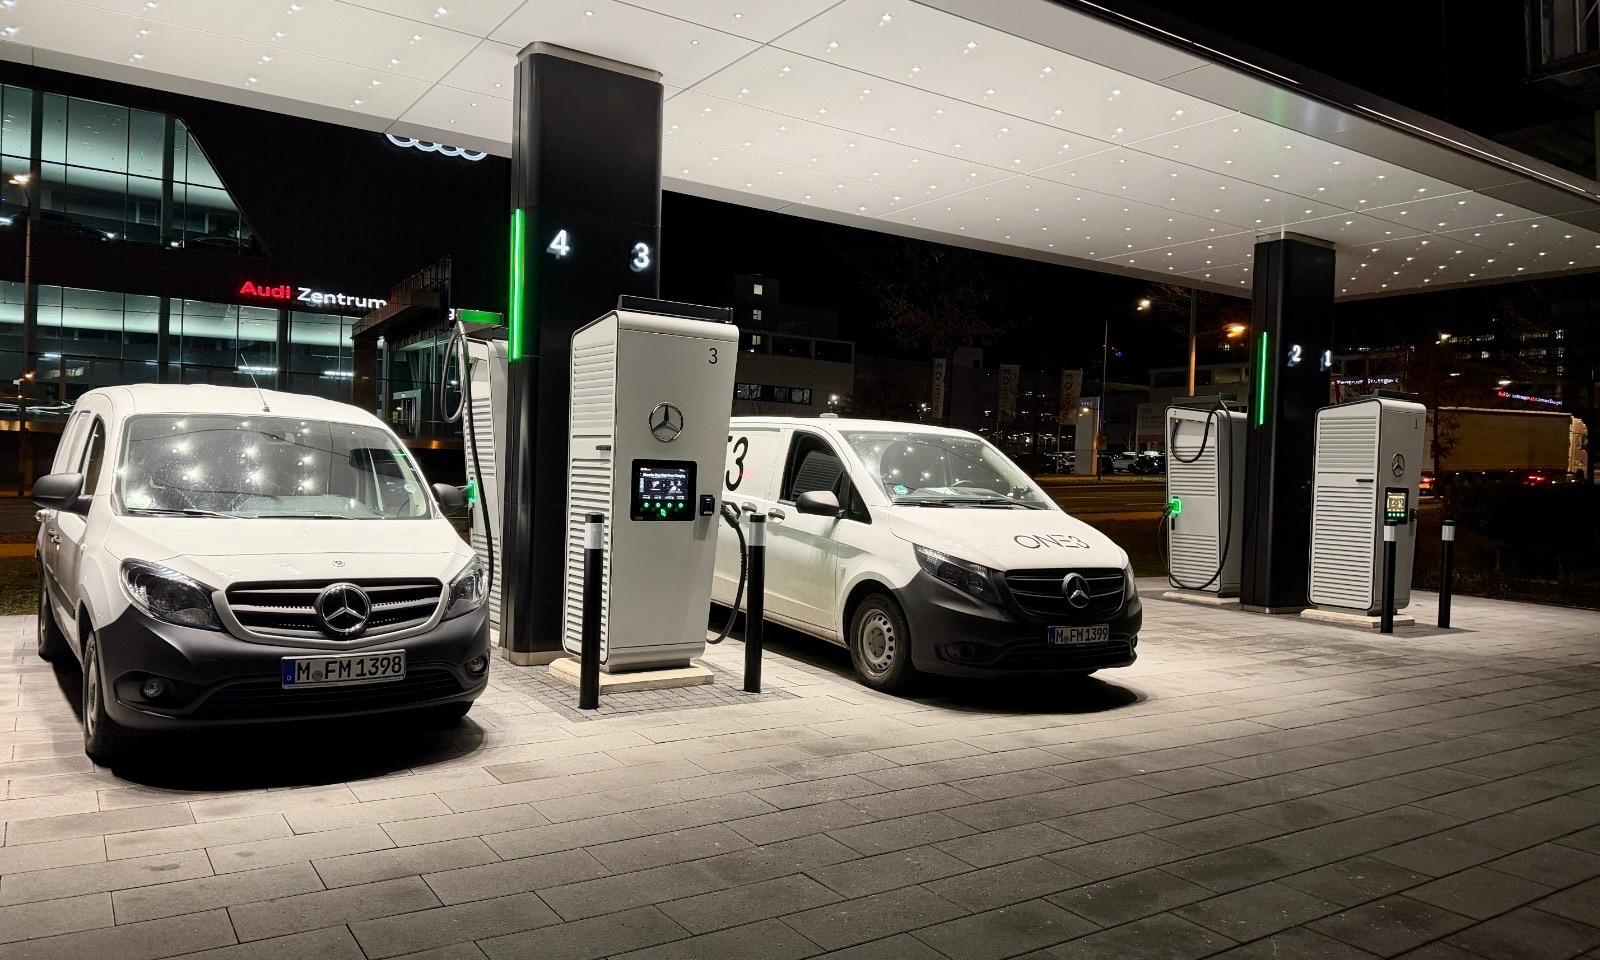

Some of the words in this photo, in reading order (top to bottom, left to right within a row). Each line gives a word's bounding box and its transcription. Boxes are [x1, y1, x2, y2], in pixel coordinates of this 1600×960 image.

[549, 229, 570, 256] 4
[632, 242, 651, 268] 3
[239, 280, 292, 300] Audi
[296, 286, 388, 309] Zentrum
[708, 347, 718, 365] 3
[1292, 344, 1302, 362] 2
[1324, 349, 1333, 367] 1
[725, 436, 749, 492] 3
[1013, 534, 1091, 550] ONE3
[1056, 629, 1064, 643] M
[297, 662, 311, 681] M
